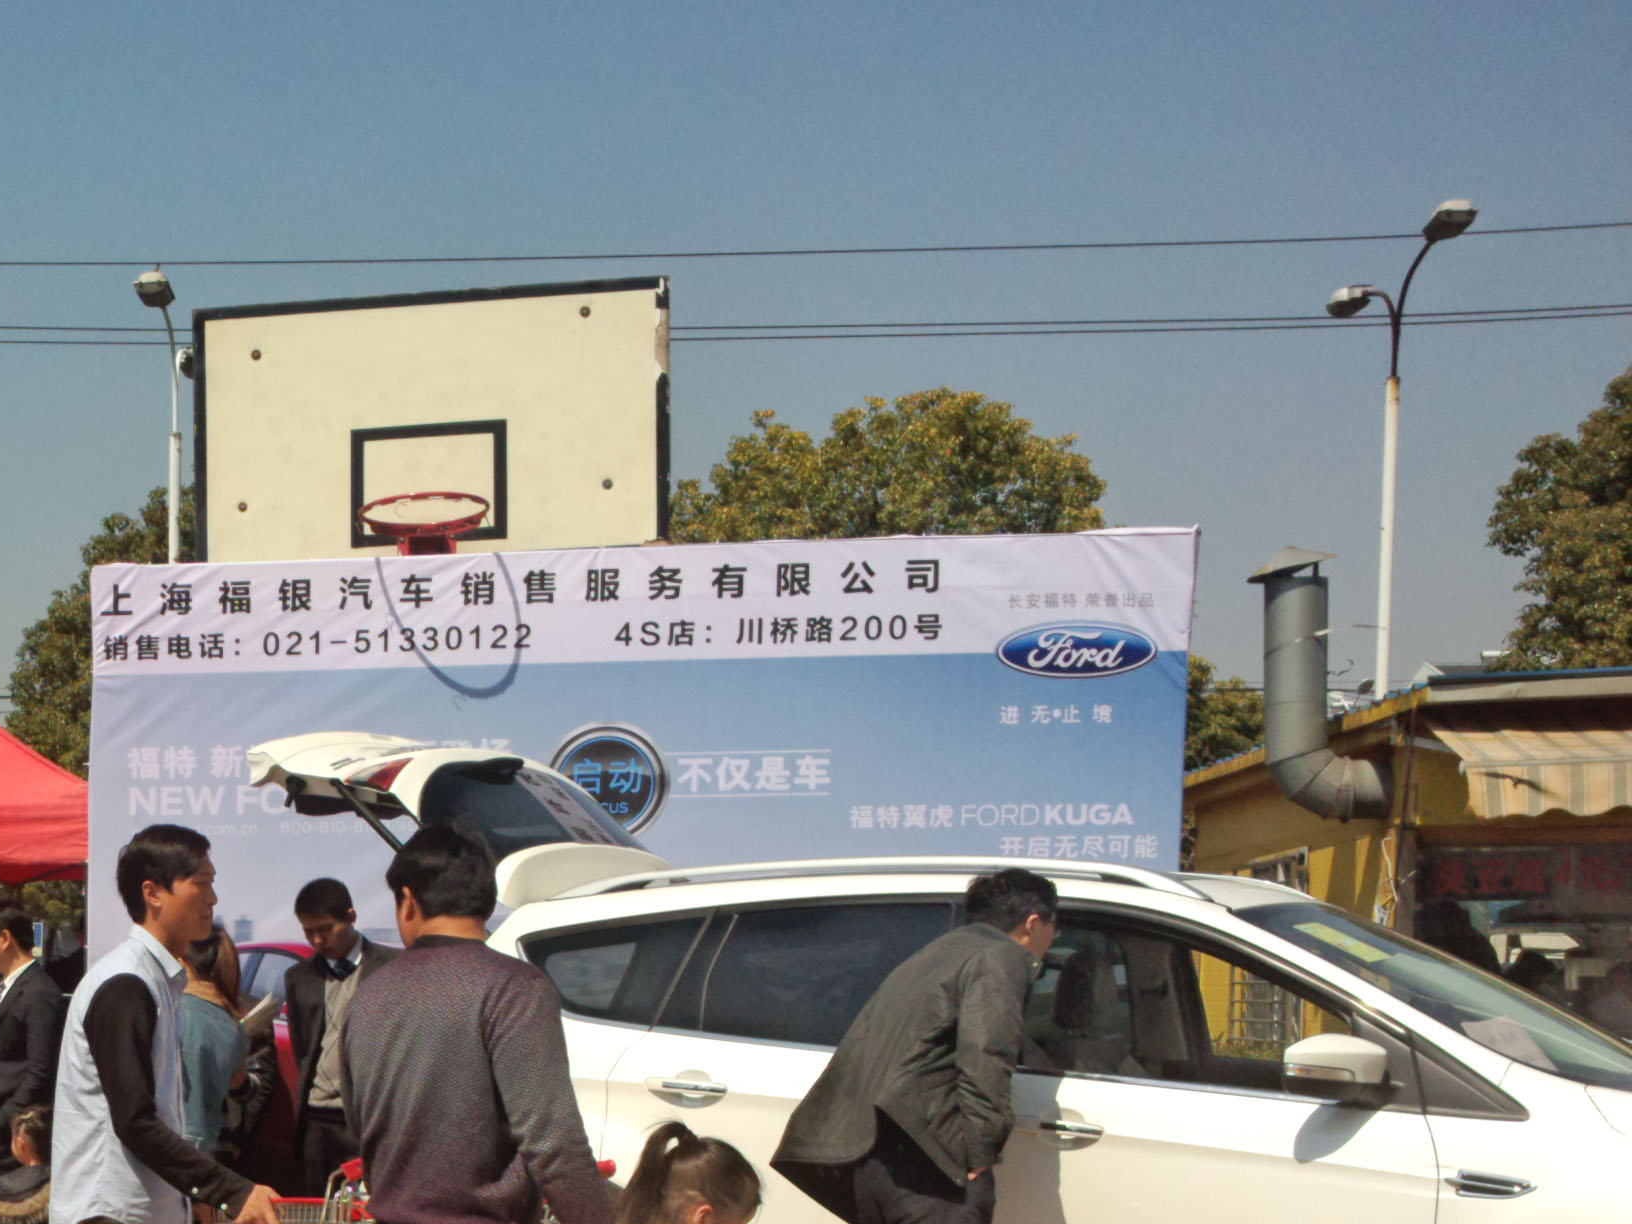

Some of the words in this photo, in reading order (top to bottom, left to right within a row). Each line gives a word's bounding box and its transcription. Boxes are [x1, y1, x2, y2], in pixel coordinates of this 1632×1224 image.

[101, 558, 942, 617] 上海福银汽车销售服务有限公司
[1027, 629, 1127, 668] Ford
[127, 745, 197, 780] 福特
[573, 757, 643, 795] 启动
[677, 755, 831, 792] 不仅是车
[128, 785, 226, 817] NEW
[236, 784, 291, 815] FO
[850, 804, 953, 829] 福特翼虎
[1044, 803, 1134, 825] KUGA
[999, 835, 1158, 859] 开启无尽可能
